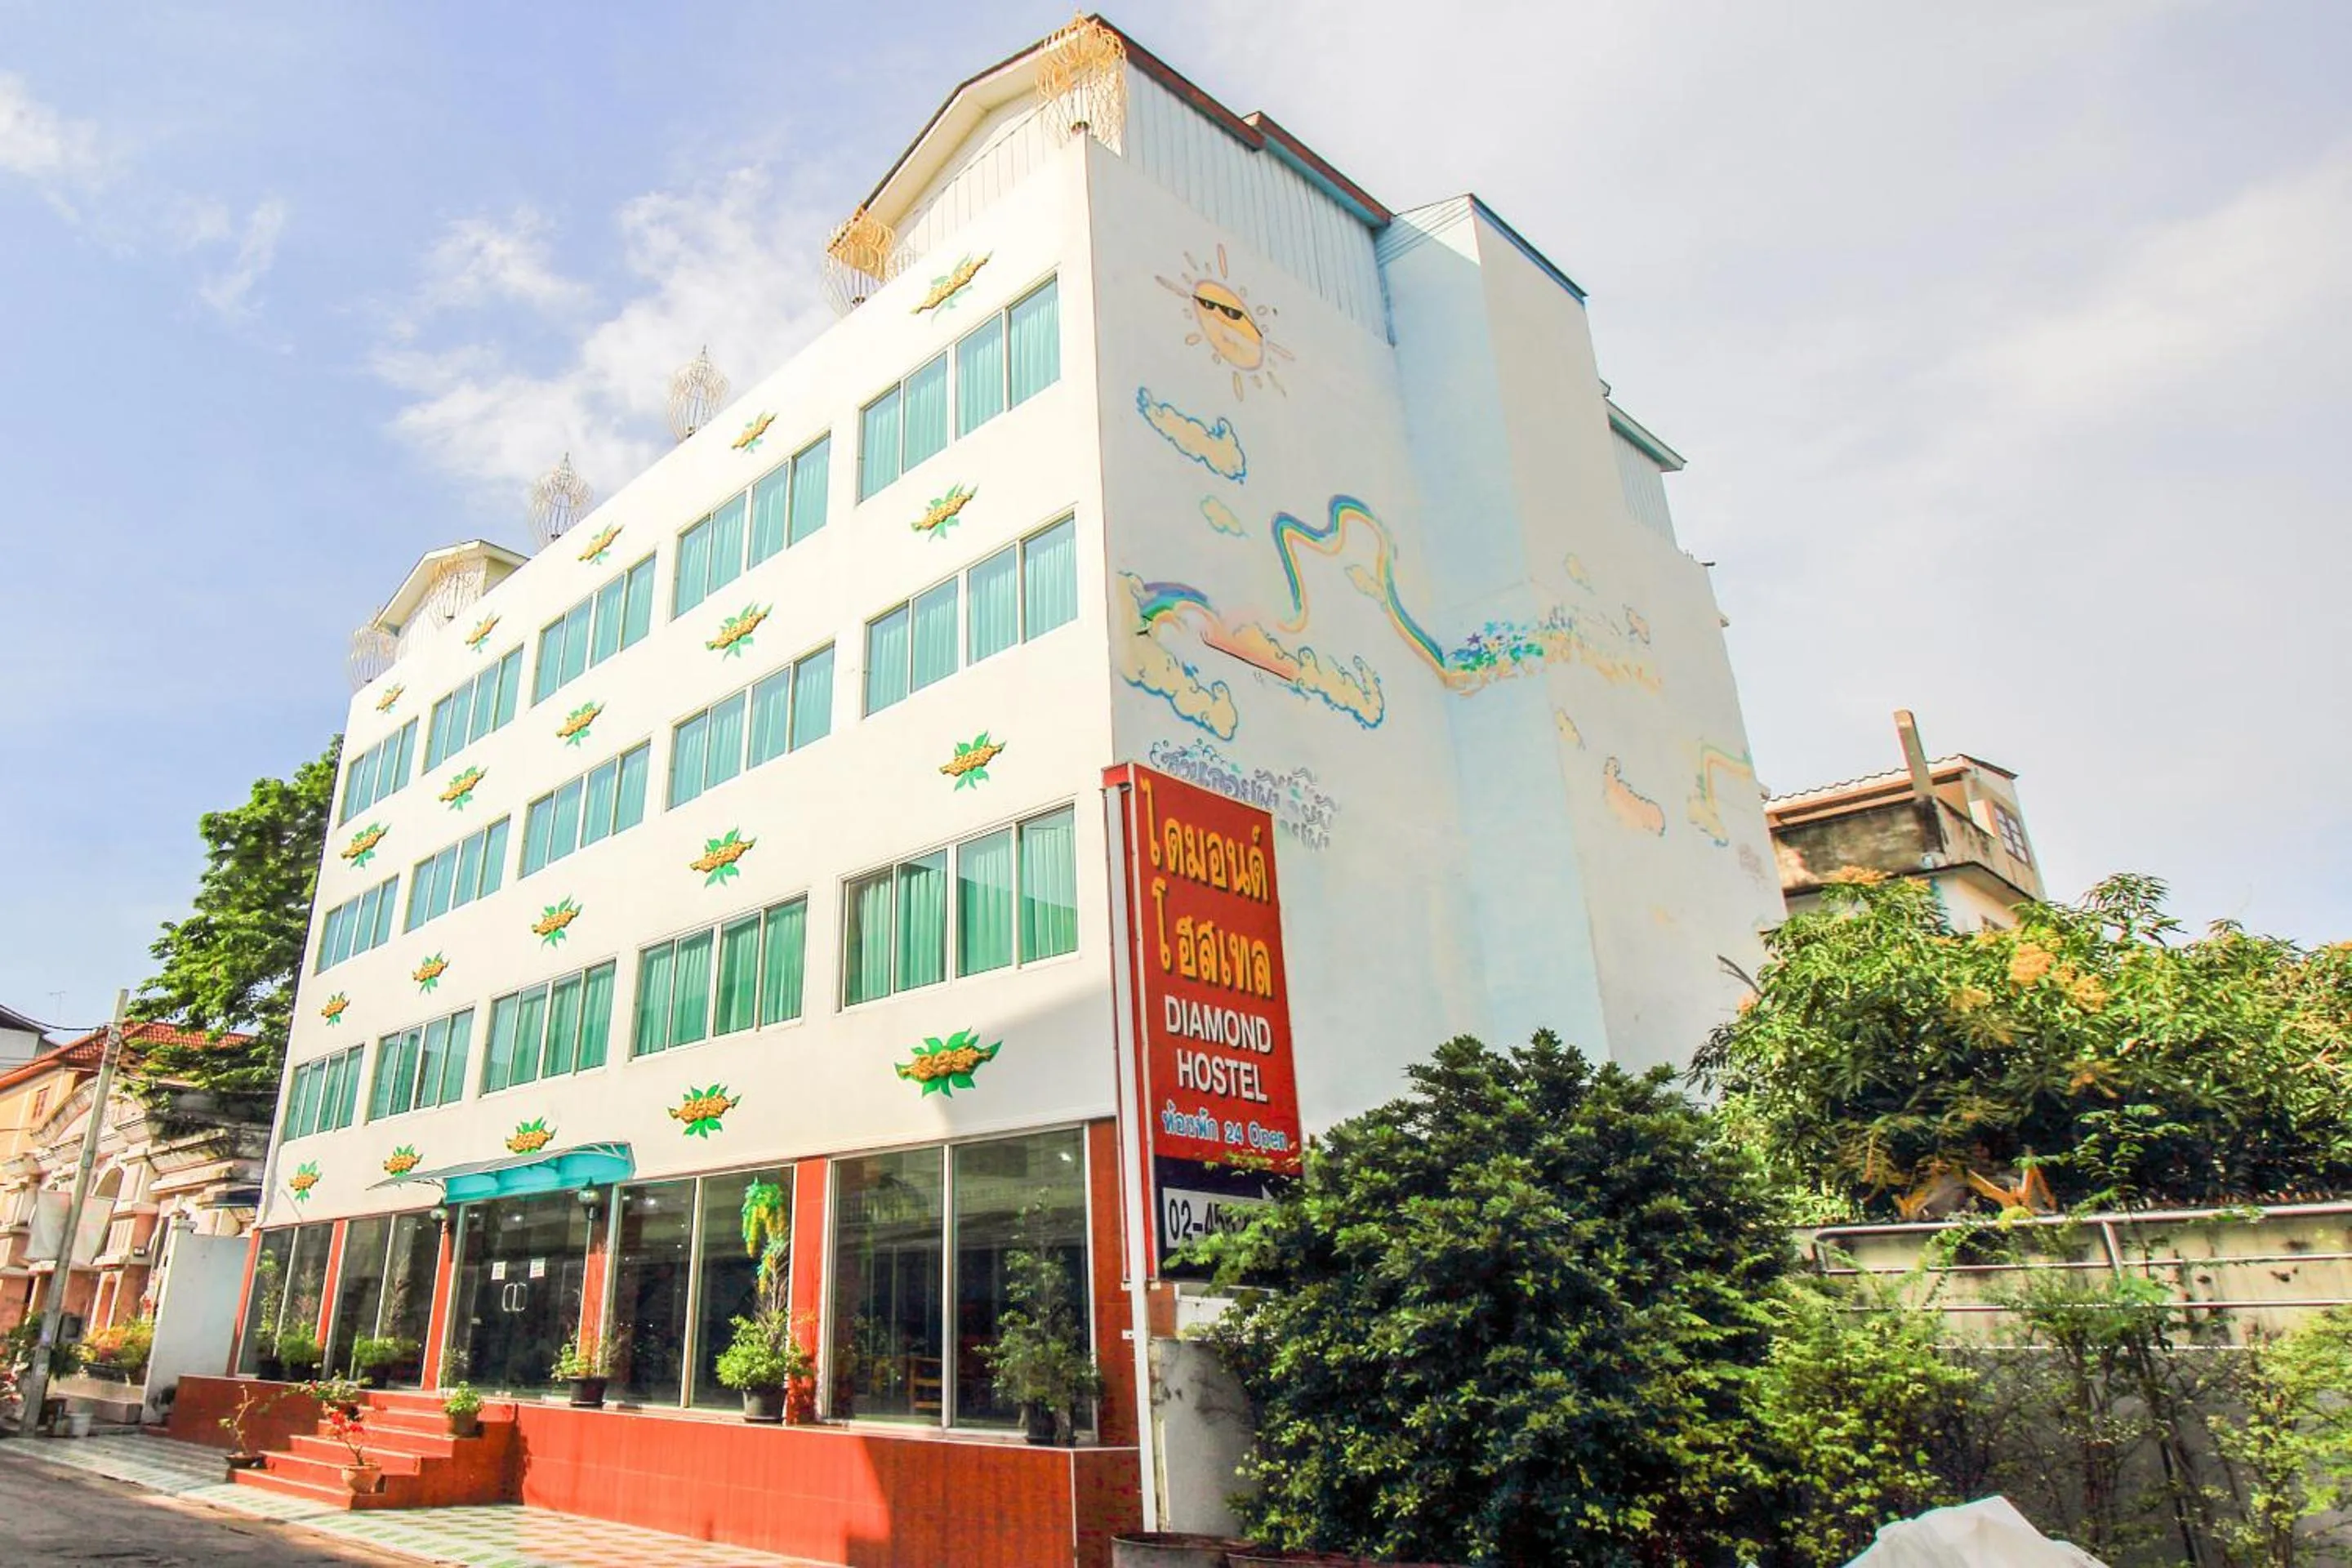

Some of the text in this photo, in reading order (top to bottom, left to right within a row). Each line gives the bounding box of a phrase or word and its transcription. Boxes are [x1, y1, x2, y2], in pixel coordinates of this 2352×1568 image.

[1141, 778, 1268, 901] ไดมอนด์
[1152, 878, 1272, 997] โฮสเทล
[1165, 995, 1272, 1053] DIAMOND
[1177, 1049, 1267, 1102] HOSTEL
[1162, 1099, 1288, 1152] ห้องพัก 24 Open
